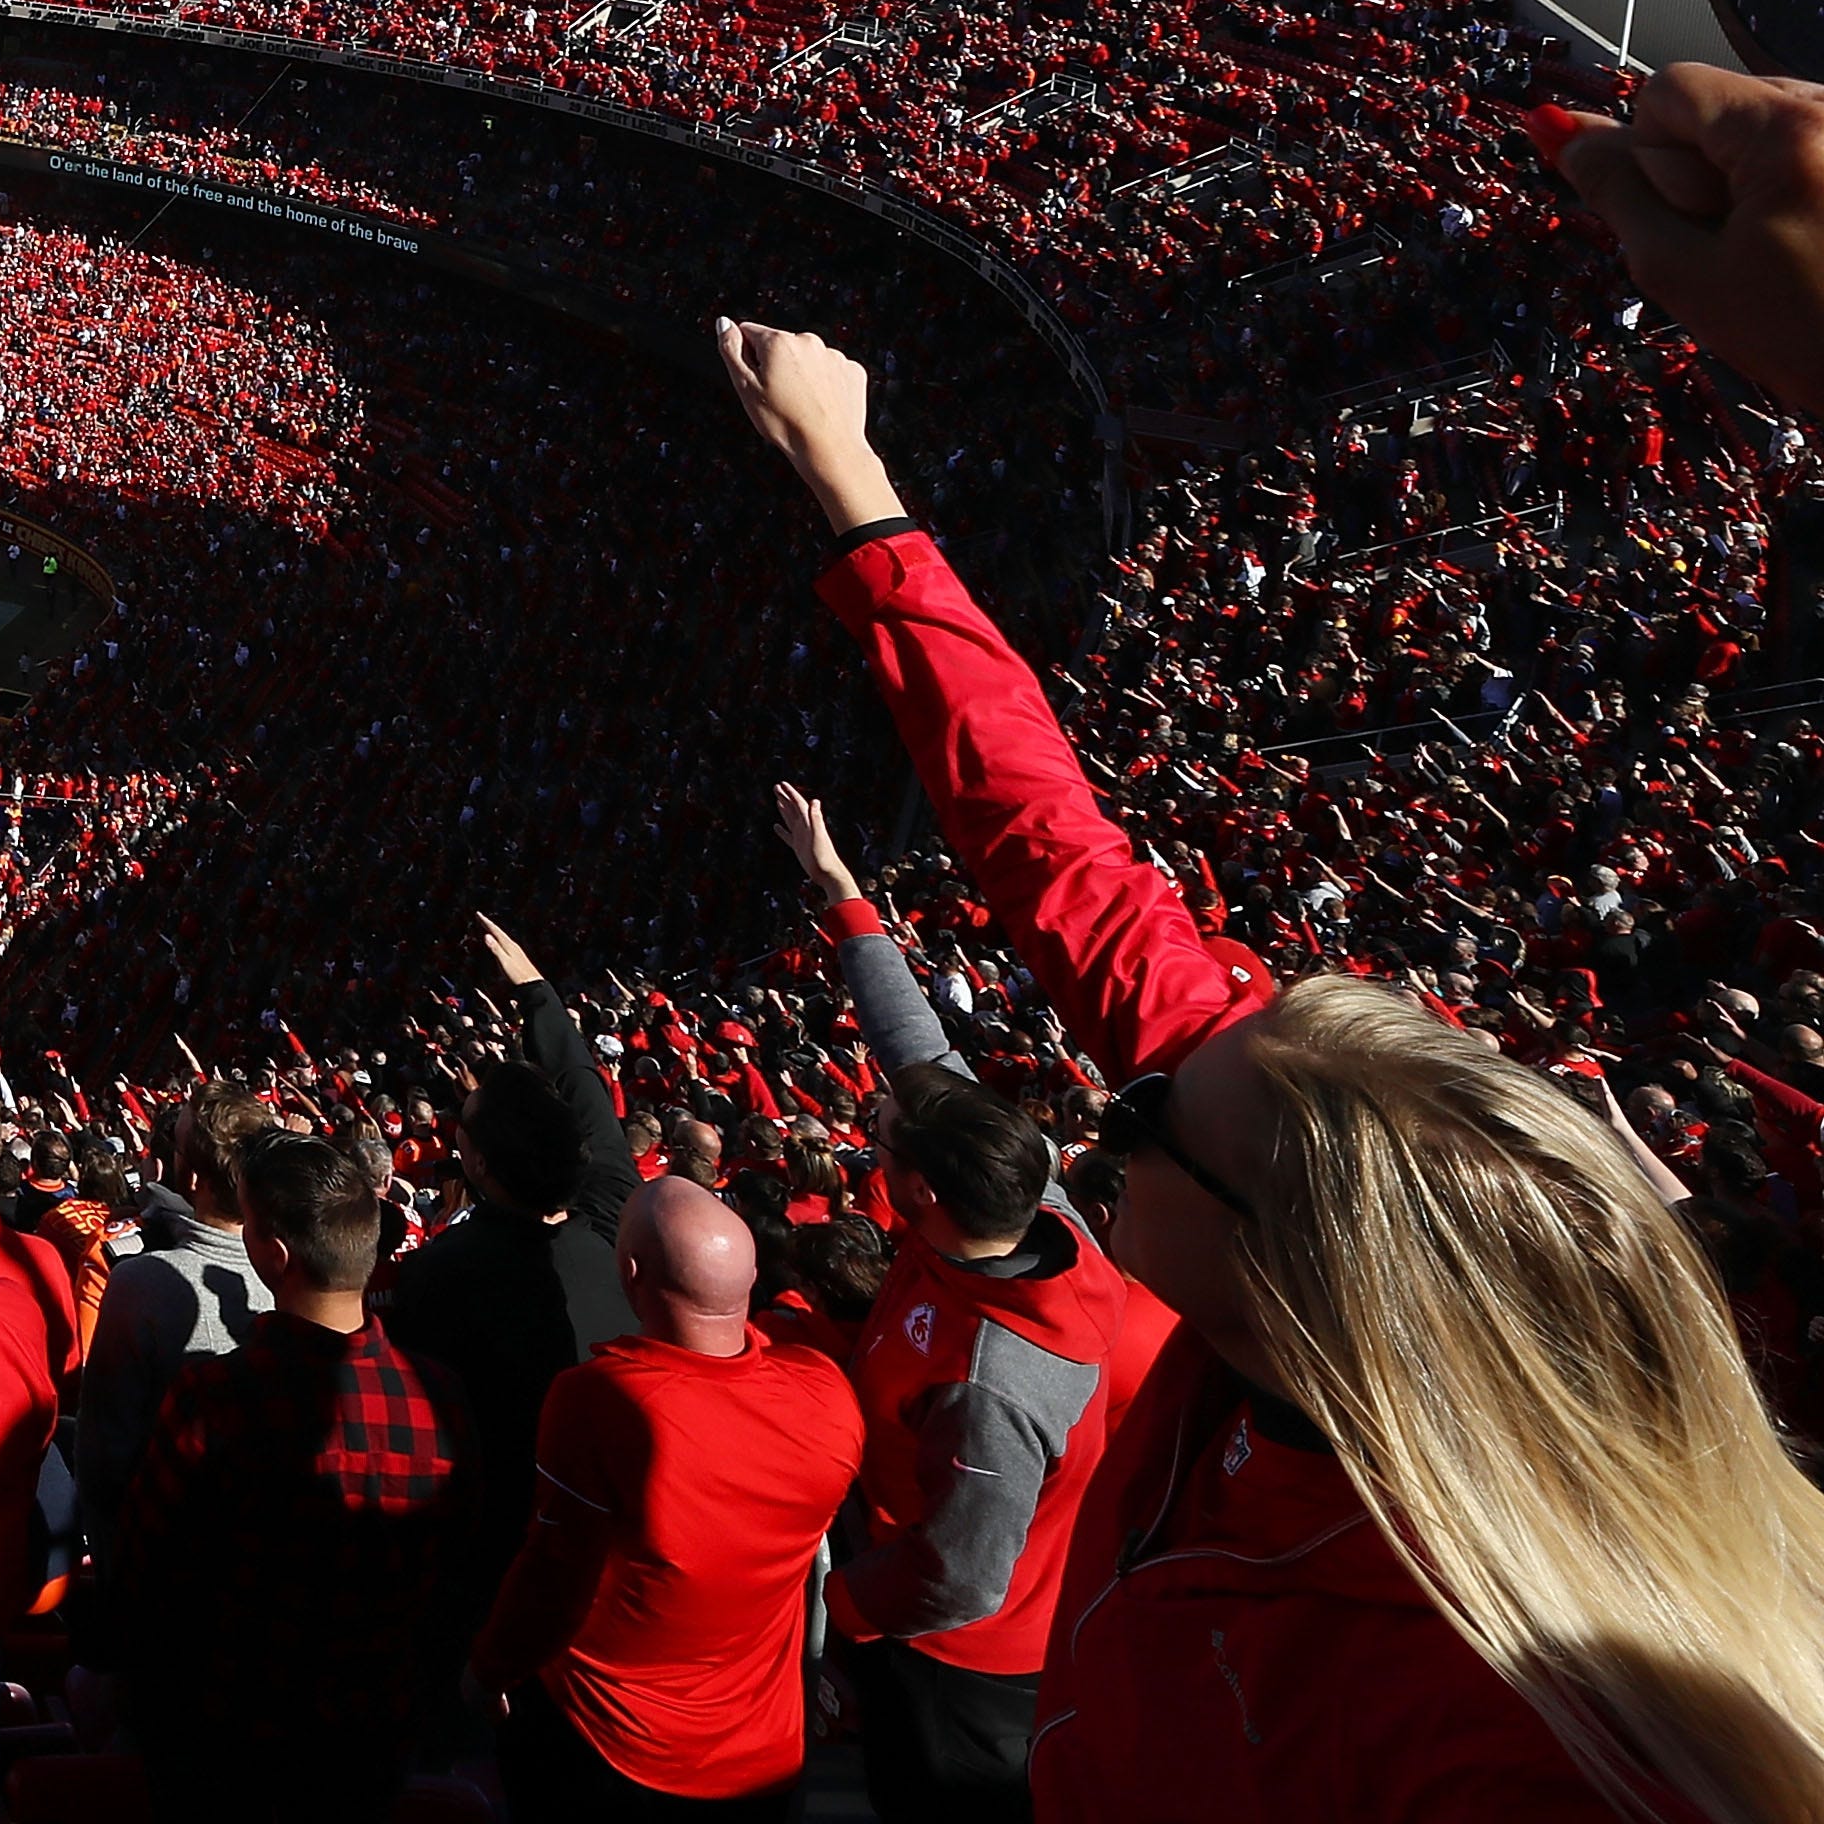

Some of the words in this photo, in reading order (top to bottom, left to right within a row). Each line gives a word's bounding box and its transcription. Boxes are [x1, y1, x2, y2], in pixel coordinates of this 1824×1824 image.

[239, 39, 262, 50] JOE
[266, 43, 322, 59] DELANEY
[49, 155, 81, 174] O'er
[85, 160, 108, 179] the
[112, 165, 143, 188] land
[147, 172, 162, 191] of
[165, 177, 189, 196] the
[192, 183, 222, 204] free
[226, 191, 254, 210] and
[257, 197, 282, 217] the
[285, 206, 327, 230] home
[330, 217, 346, 235] of
[348, 222, 373, 240] the
[376, 230, 418, 254] brave
